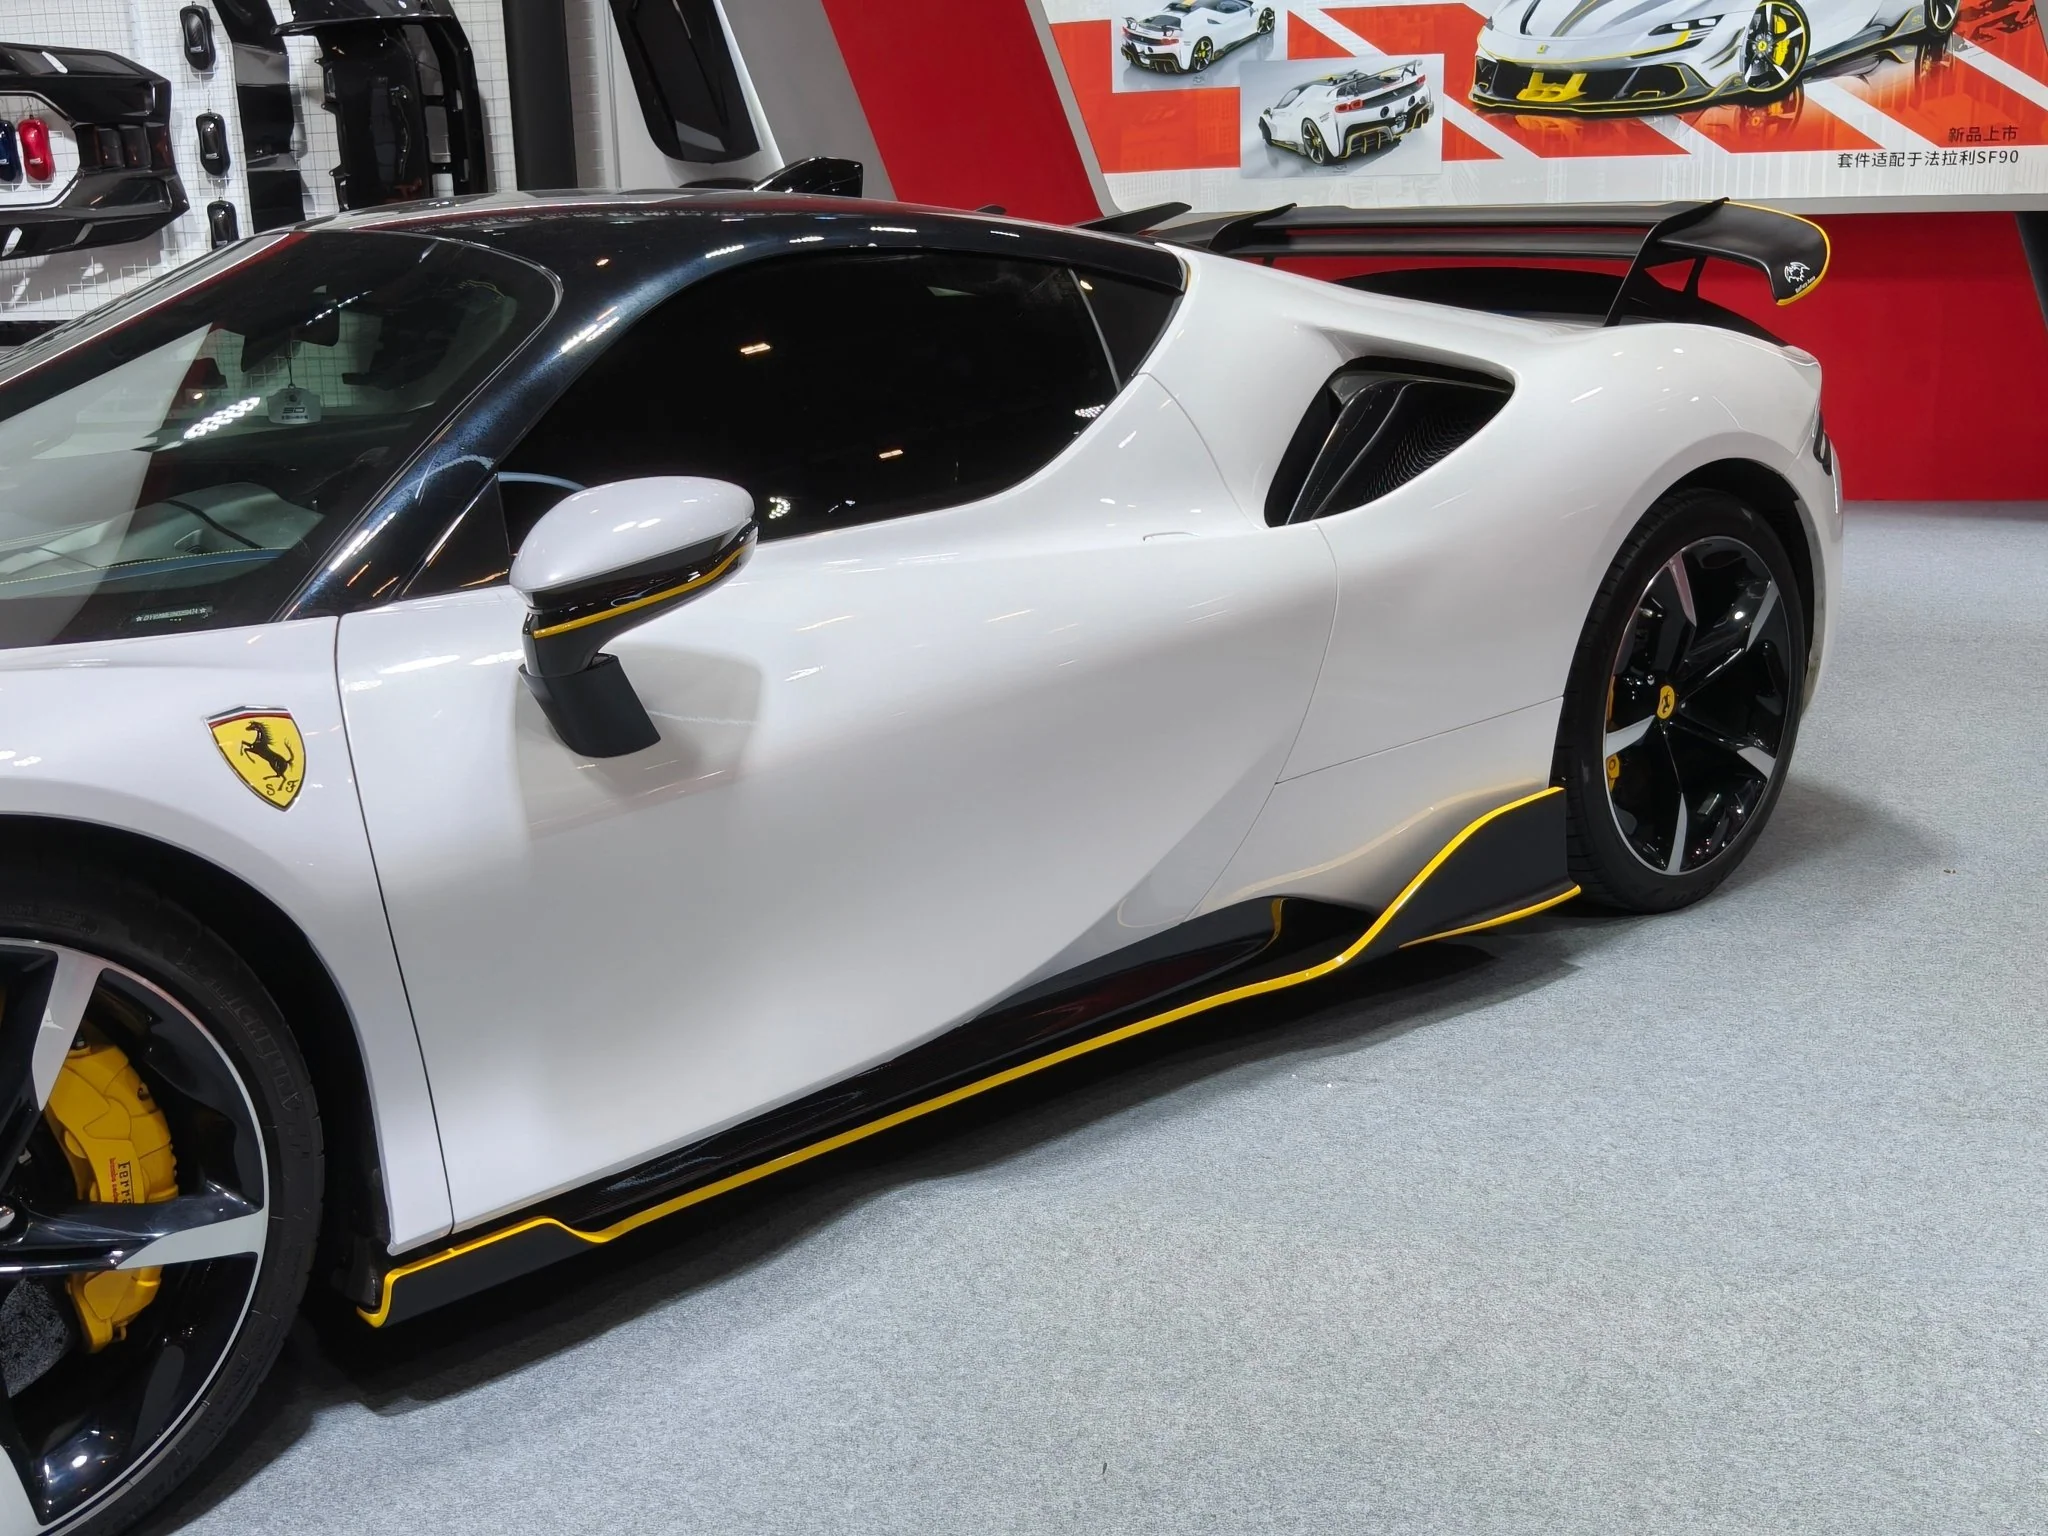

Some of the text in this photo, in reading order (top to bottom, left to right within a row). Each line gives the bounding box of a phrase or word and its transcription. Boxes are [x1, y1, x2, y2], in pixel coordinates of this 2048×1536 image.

[1948, 125, 2018, 142] 新品上市
[1838, 150, 2019, 168] 套件适配于法拉利SF90
[265, 779, 299, 796] S F
[118, 1161, 134, 1204] Ferra
